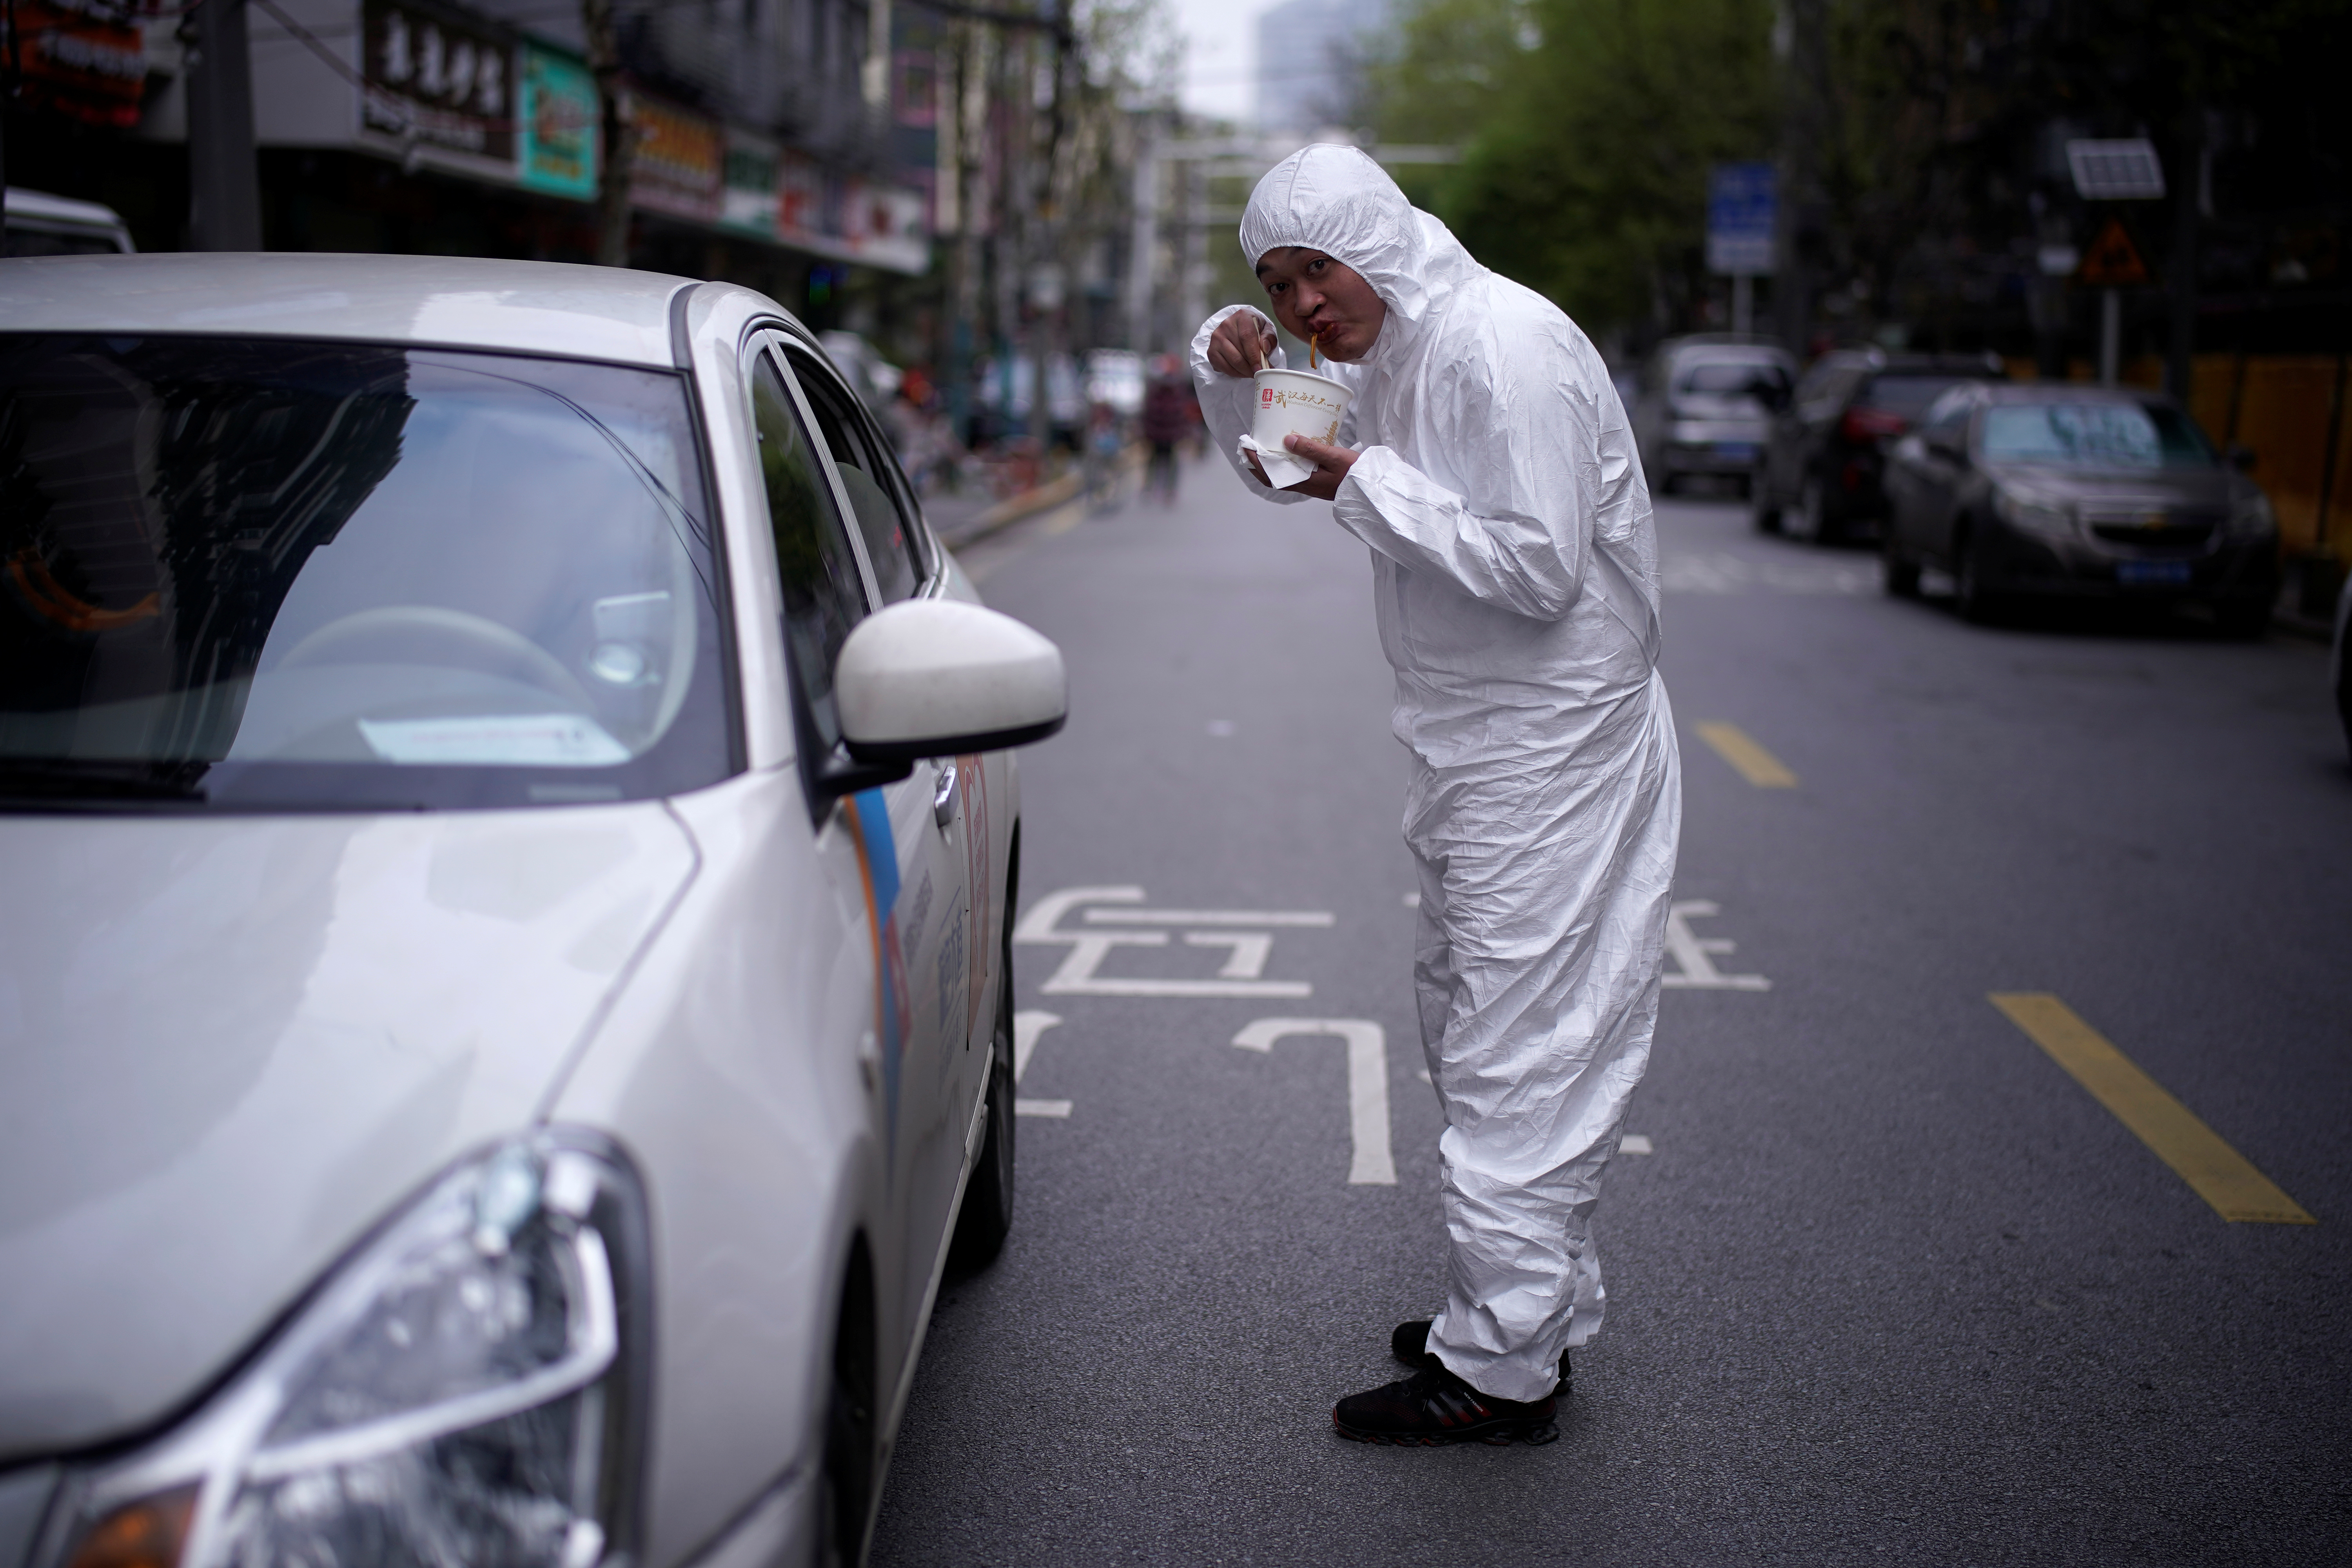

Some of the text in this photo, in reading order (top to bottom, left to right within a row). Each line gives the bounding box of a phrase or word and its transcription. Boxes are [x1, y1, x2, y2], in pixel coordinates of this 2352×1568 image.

[1274, 390, 1341, 414] 武汉每天不一样
[1303, 403, 1322, 411] Different
[1463, 1392, 1484, 1412] NEW FASHION
